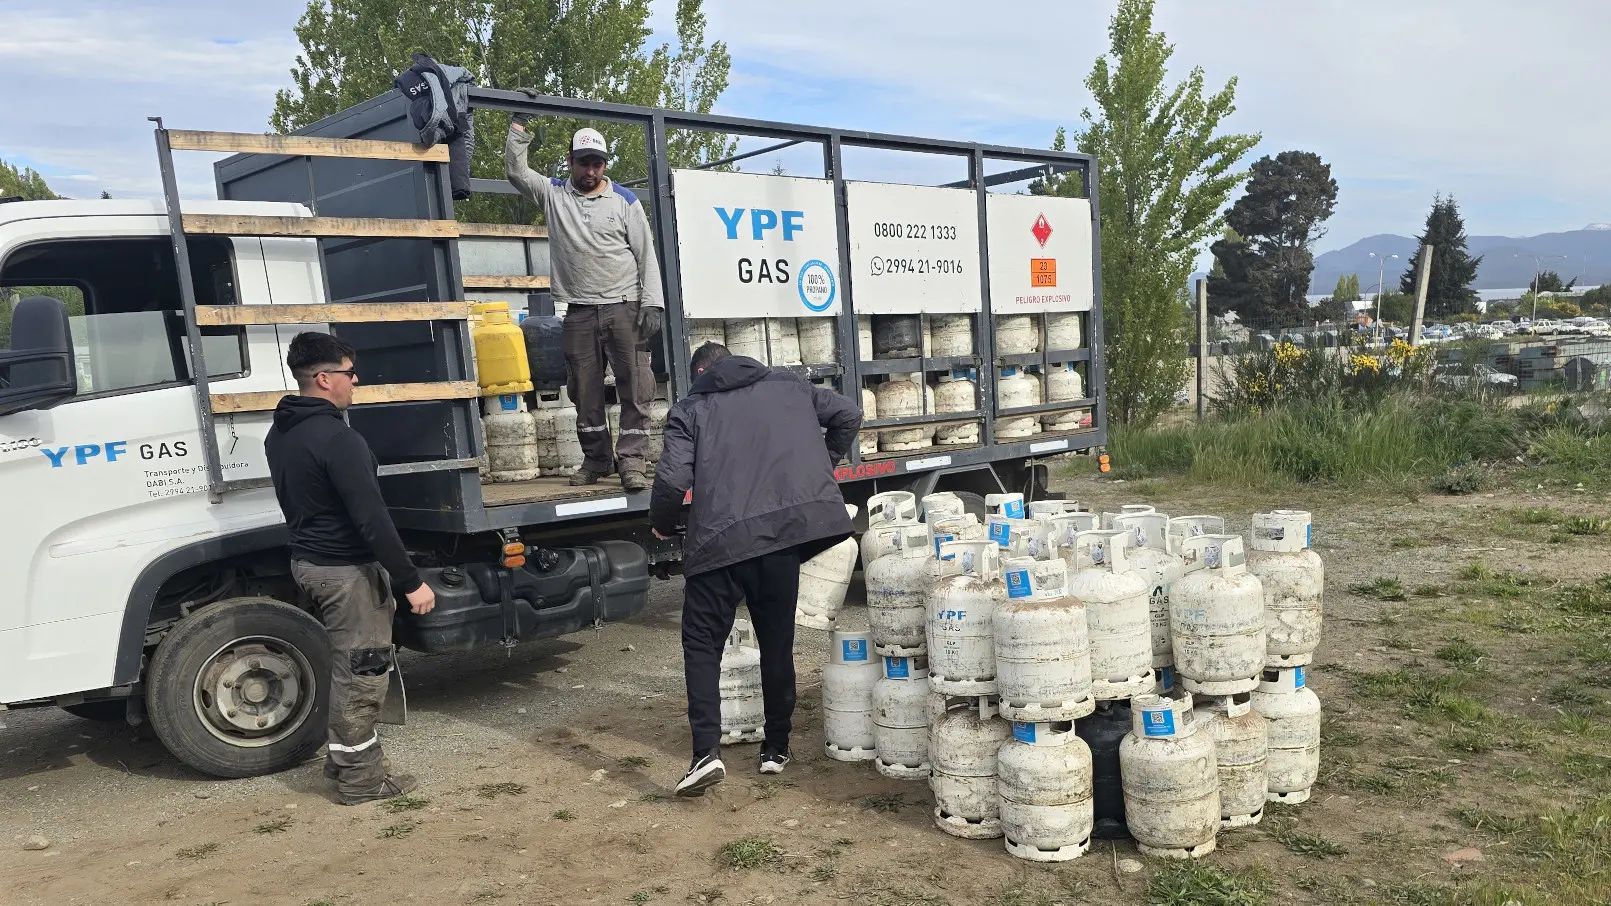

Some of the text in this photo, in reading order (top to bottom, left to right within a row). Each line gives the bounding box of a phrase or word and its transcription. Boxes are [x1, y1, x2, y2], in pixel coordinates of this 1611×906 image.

[713, 206, 804, 242] YPF
[874, 222, 956, 240] 0800 222 1333
[738, 258, 790, 284] GAS
[886, 259, 963, 274] 2994 21-9016
[1040, 262, 1048, 270] 23
[807, 274, 826, 285] 100%
[1036, 275, 1052, 284] 1075
[806, 286, 828, 294] PROPANO
[1015, 294, 1071, 304] PELIGRO EXPLOSIVO
[40, 440, 188, 468] YPF GAS
[144, 467, 190, 478] Transporte
[198, 462, 249, 472] Disbuidora
[834, 460, 896, 480] XPLOSIVO
[146, 479, 166, 488] DABI
[148, 484, 212, 498] Tel. 2994 21-901
[938, 610, 967, 620] YPF
